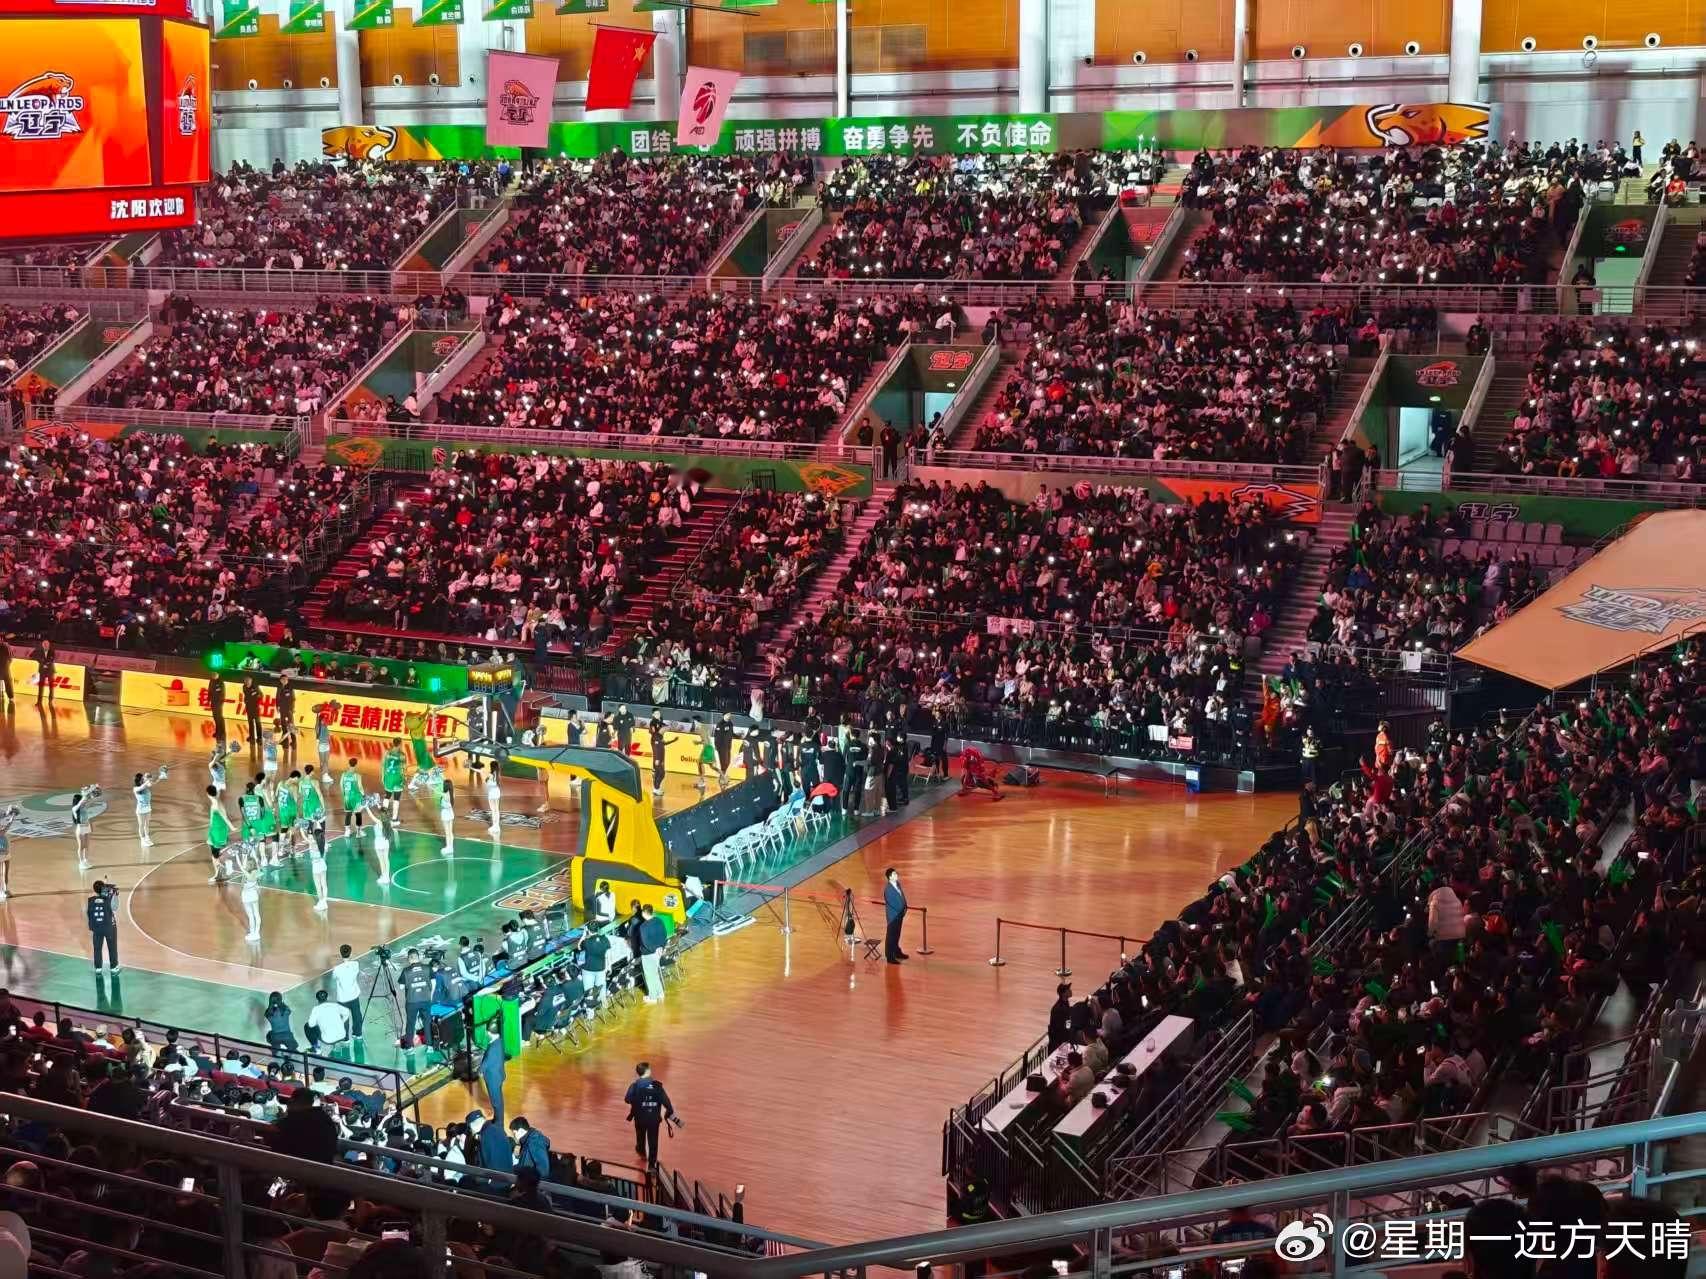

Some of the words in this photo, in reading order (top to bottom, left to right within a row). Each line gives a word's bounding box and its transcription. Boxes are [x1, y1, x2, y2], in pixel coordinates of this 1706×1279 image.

[17, 99, 82, 110] LEOPARDS
[18, 110, 66, 136] 辽宁
[631, 129, 712, 153] 团结
[735, 127, 822, 153] 顽强拼搏
[843, 124, 934, 150] 奋勇争先
[957, 122, 1053, 147] 不负使命
